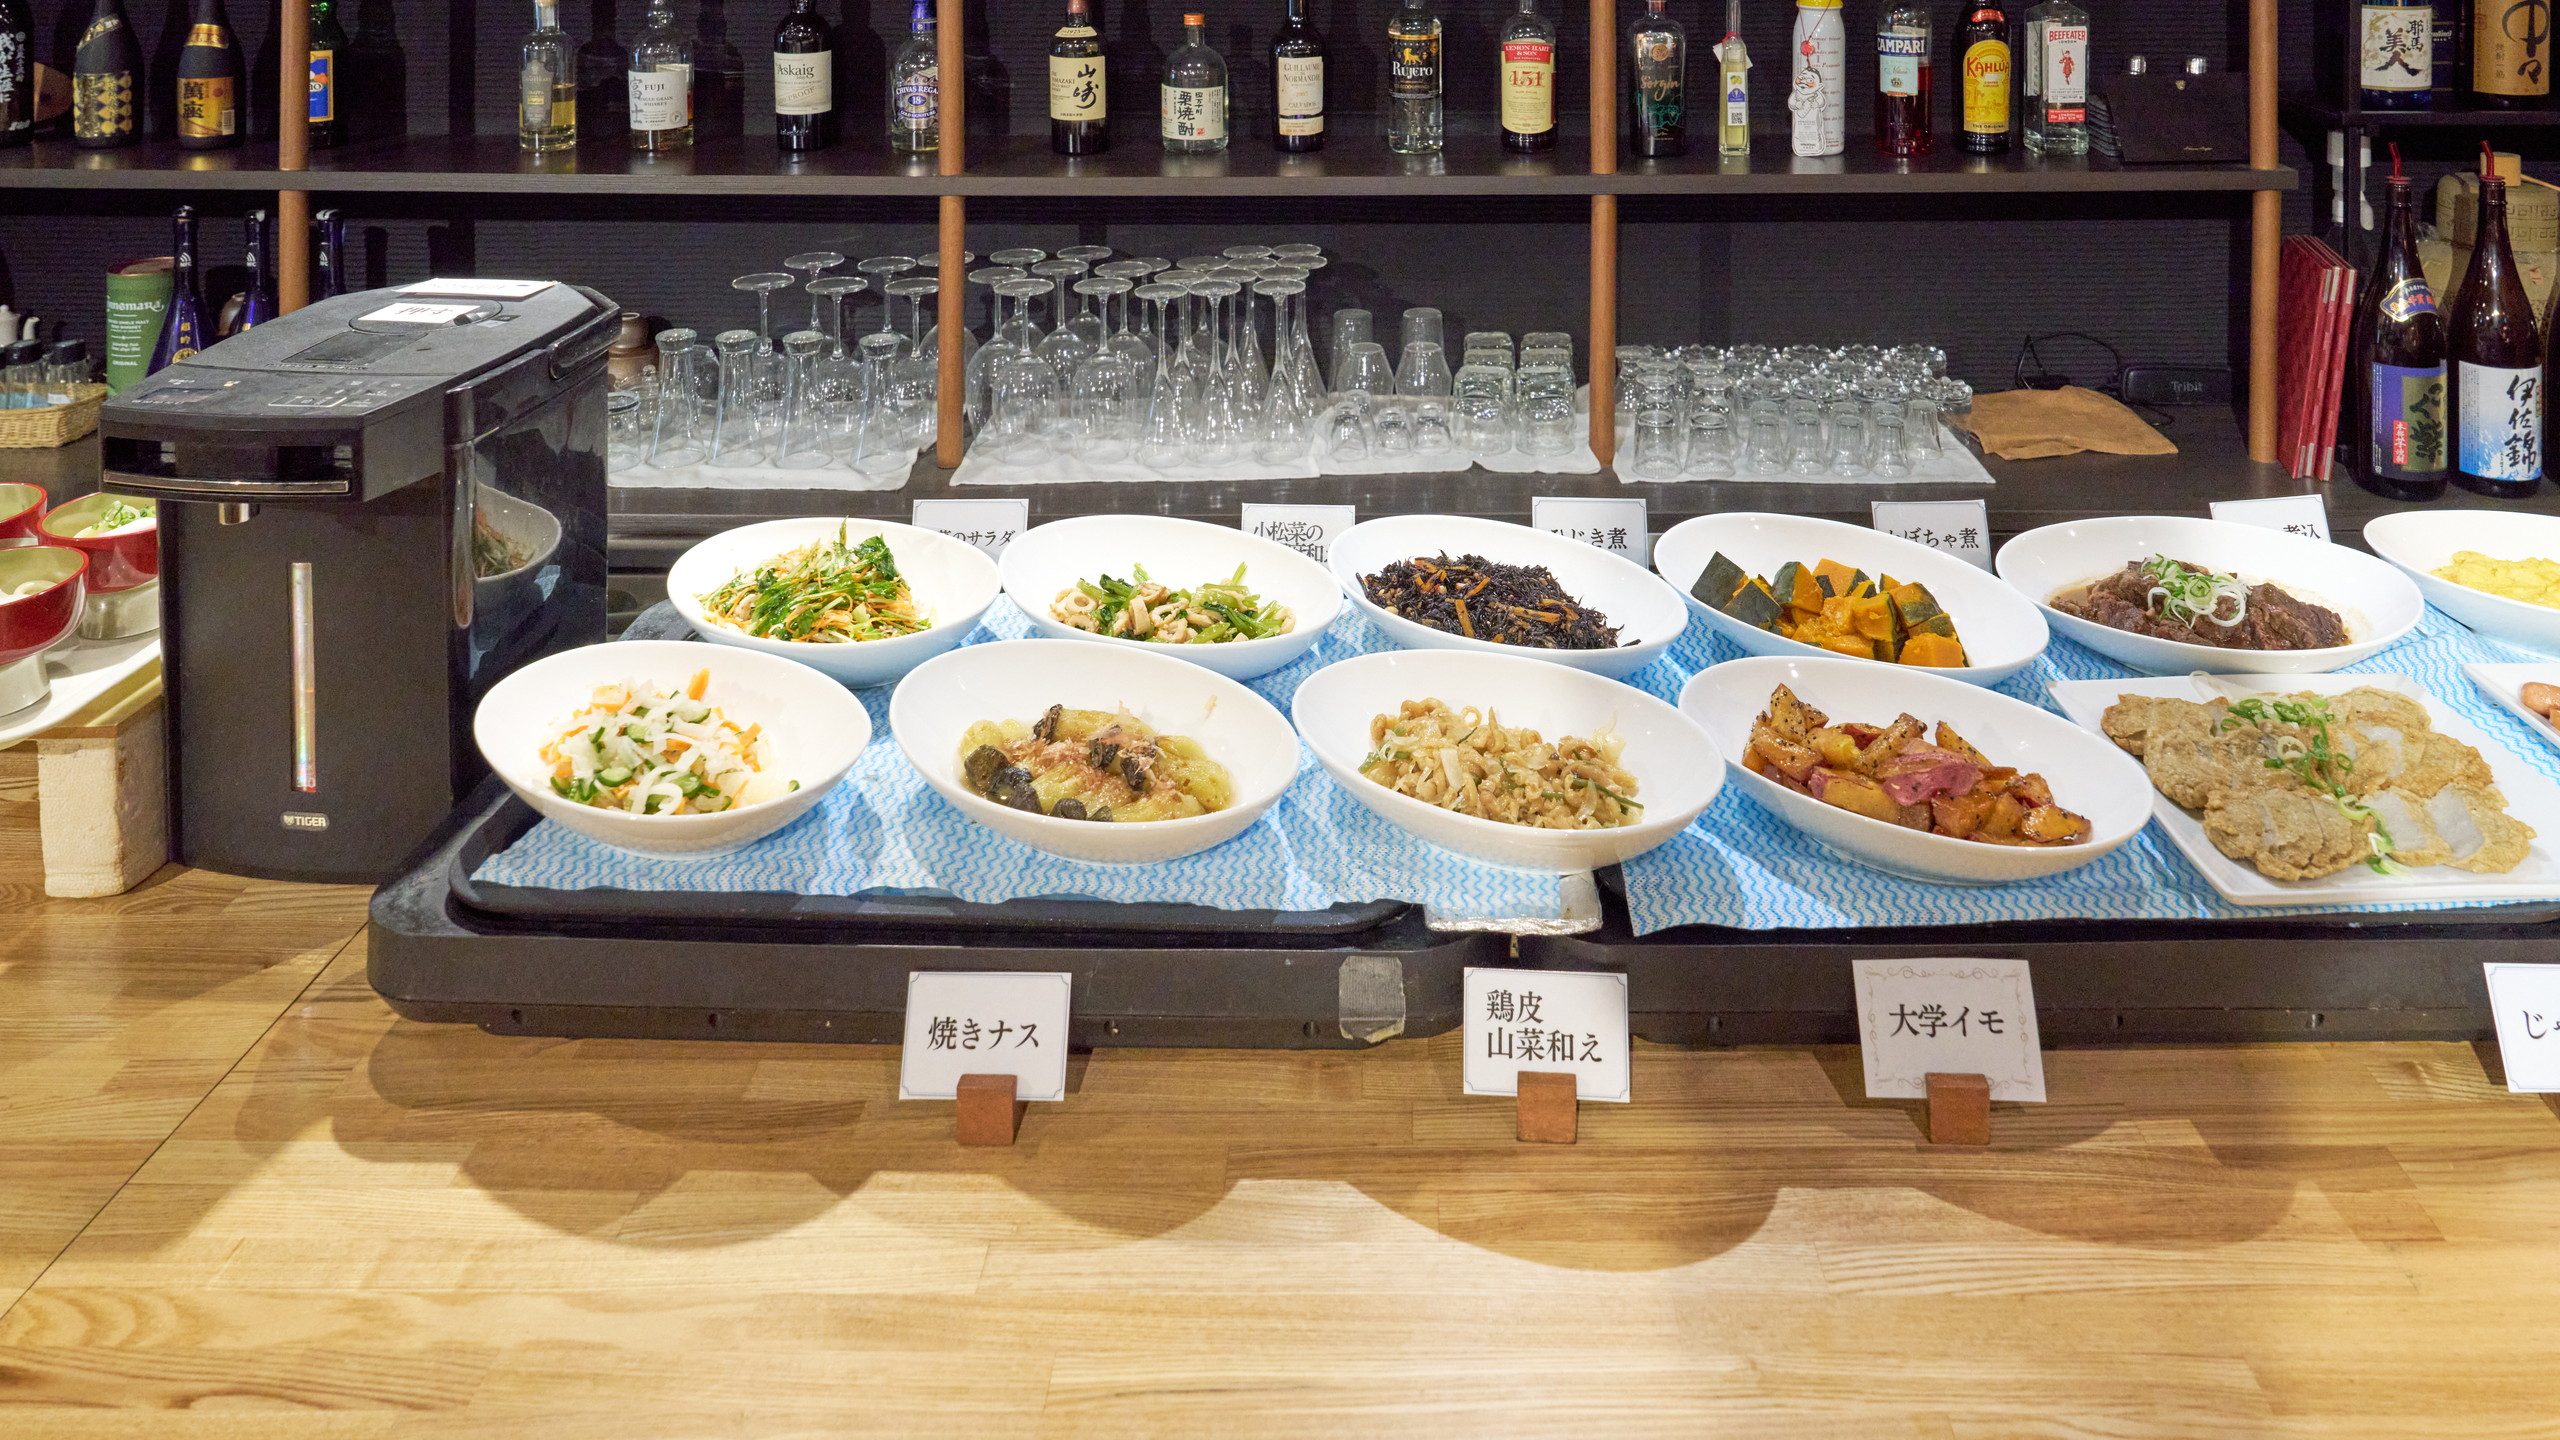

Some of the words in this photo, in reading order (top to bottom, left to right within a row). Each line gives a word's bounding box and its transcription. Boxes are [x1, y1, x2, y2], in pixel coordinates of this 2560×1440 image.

[1877, 37, 1925, 53] CAMPARI
[2048, 30, 2086, 42] BEEFEATER
[2374, 27, 2423, 77] 美人
[777, 63, 815, 79] Askaig
[1392, 60, 1433, 79] Rujero
[1966, 56, 2009, 78] KAHLÚA
[644, 83, 665, 91] FUJI
[1072, 63, 1099, 109] 山崎
[1510, 70, 1545, 87] 151
[896, 84, 918, 95] CHIVAS
[630, 76, 643, 124] 富士
[912, 96, 922, 105] 18
[1177, 90, 1196, 137] 栗焼酎
[2170, 380, 2204, 392] Tribit
[2505, 373, 2538, 475] 伊佐錦
[939, 529, 1016, 547] のサラダ
[295, 815, 326, 827] TIGER
[1486, 989, 1545, 1024] 鶏皮
[1888, 1003, 2005, 1038] 大学イモ
[926, 1016, 1040, 1051] 焼きナス
[1487, 1026, 1603, 1063] 山菜和え
